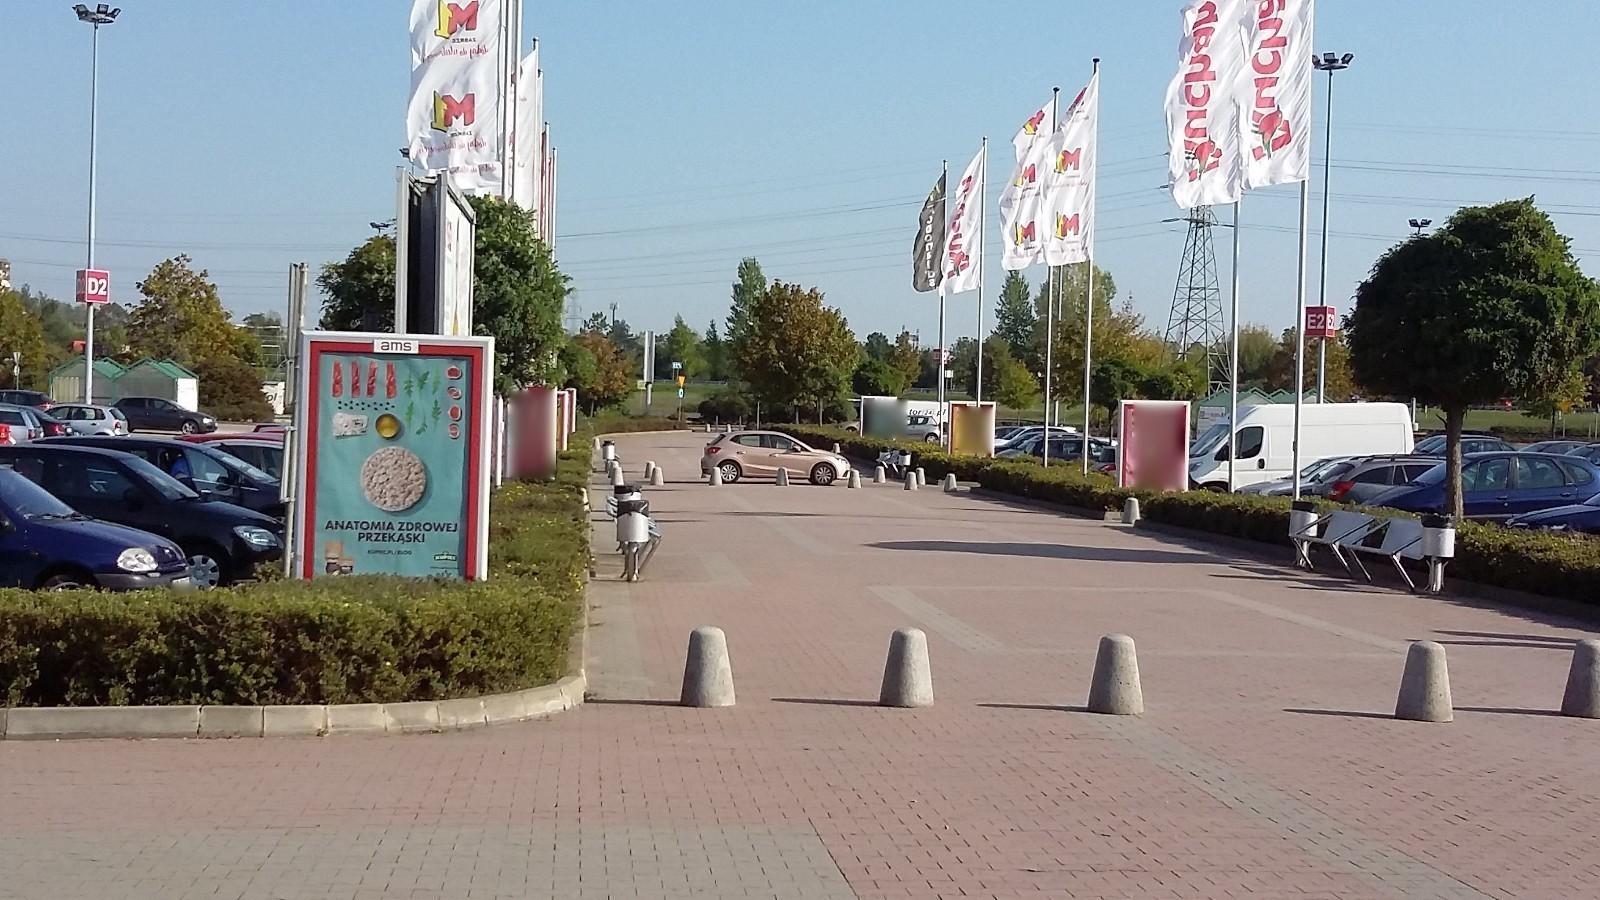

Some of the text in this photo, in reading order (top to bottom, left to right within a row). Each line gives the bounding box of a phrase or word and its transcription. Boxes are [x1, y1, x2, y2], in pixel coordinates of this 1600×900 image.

[88, 277, 107, 296] D2
[1307, 313, 1325, 330] E2
[380, 341, 412, 351] ams
[325, 520, 458, 532] ANATOMIA ZDROWEJ
[358, 532, 425, 544] PRZEKĄSKI
